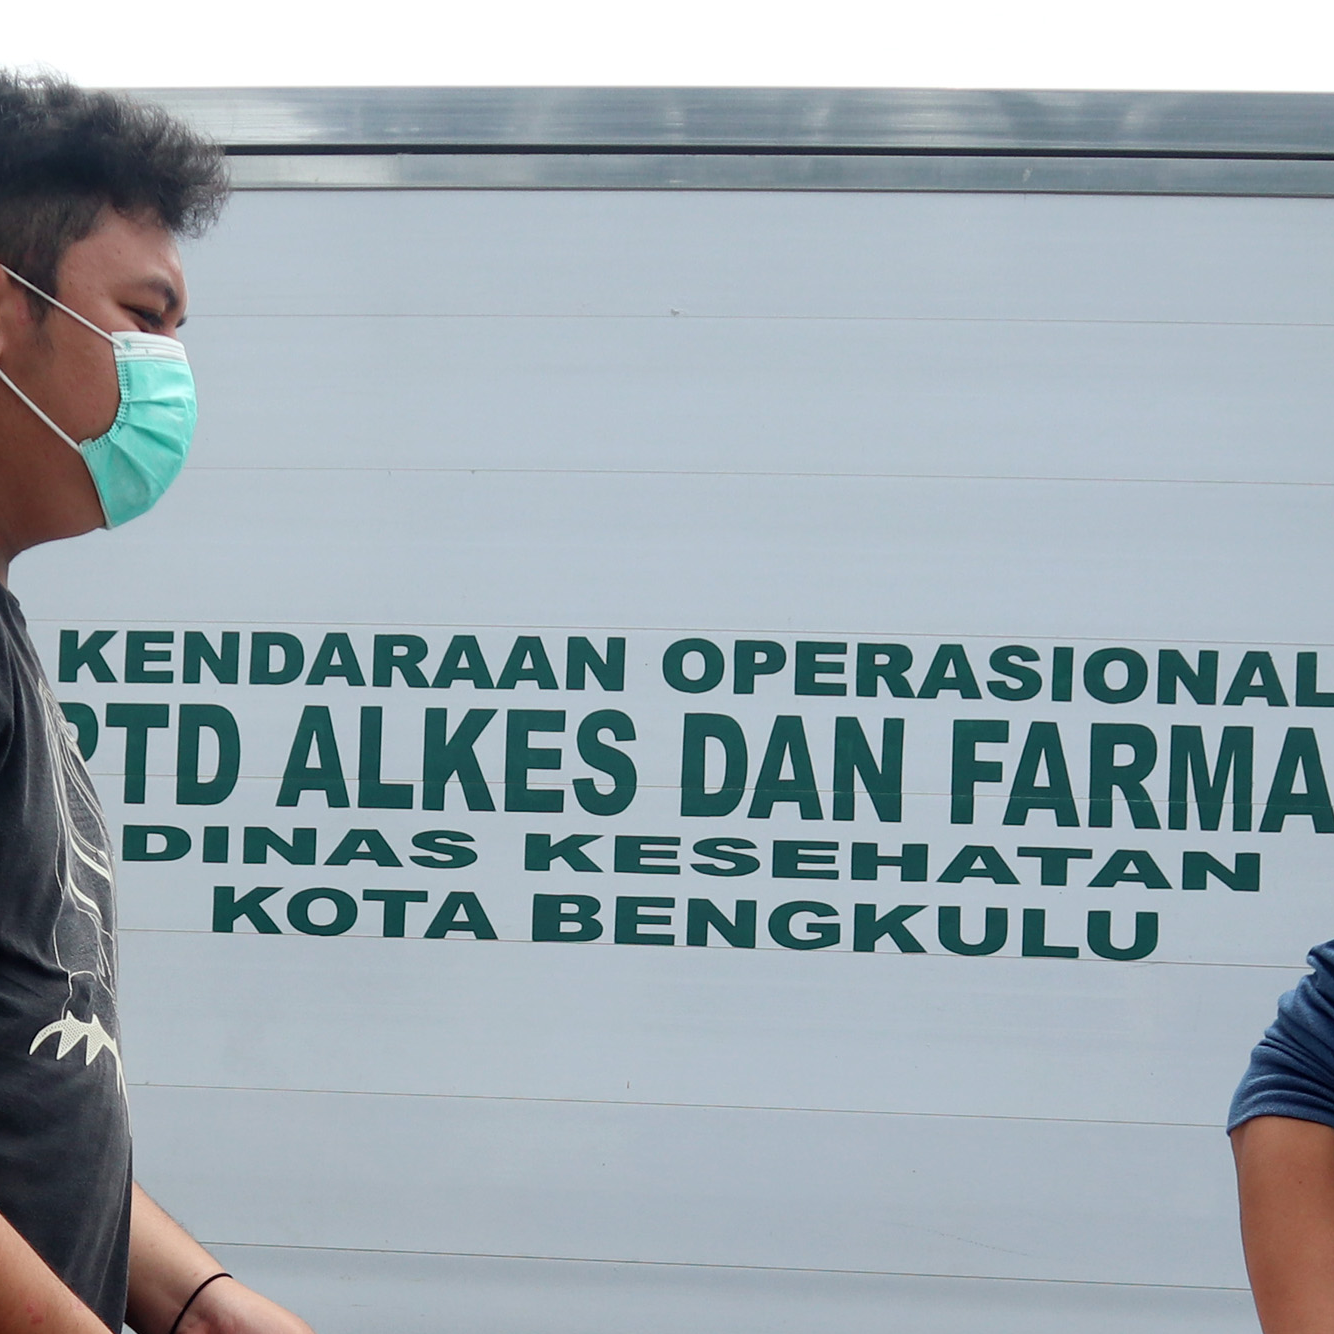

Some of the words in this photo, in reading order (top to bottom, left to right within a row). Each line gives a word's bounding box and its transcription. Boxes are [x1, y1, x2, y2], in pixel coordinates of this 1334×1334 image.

[58, 630, 625, 691] KENDARAAN
[275, 704, 638, 817] ALKES
[680, 712, 905, 823] DAN
[122, 824, 478, 869] DINAS
[524, 832, 1261, 892] KESEHATAN
[212, 885, 499, 941] KOTA
[531, 893, 1159, 962] BENGKULU
